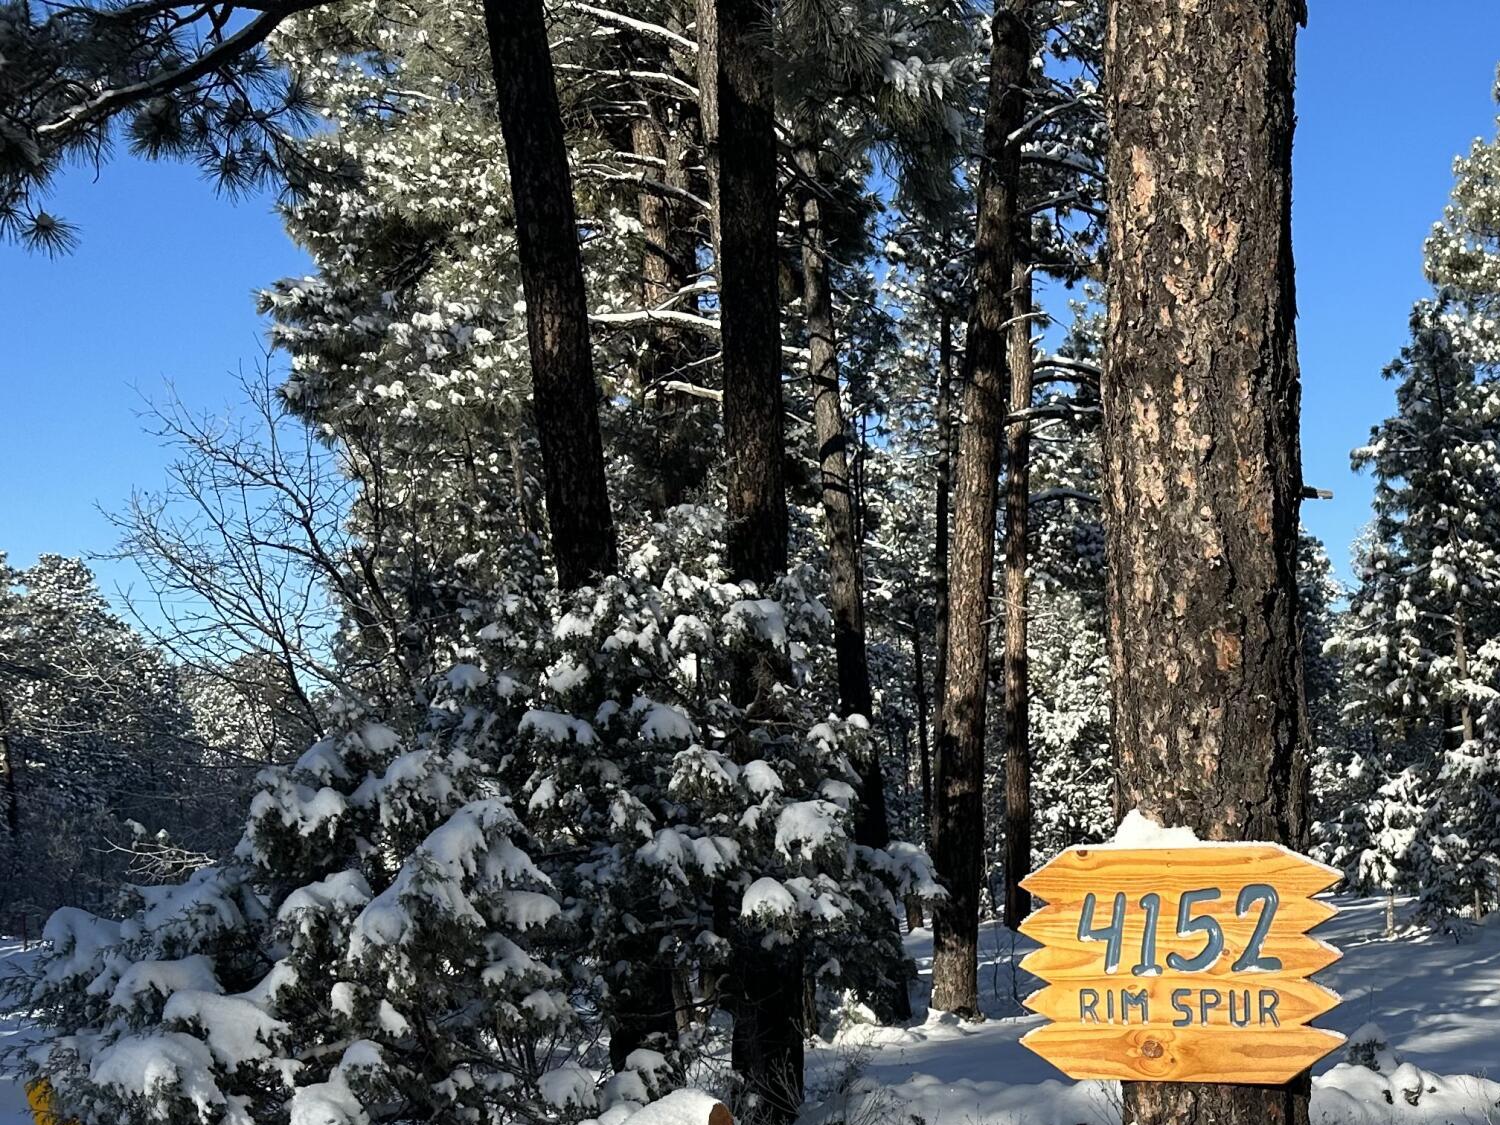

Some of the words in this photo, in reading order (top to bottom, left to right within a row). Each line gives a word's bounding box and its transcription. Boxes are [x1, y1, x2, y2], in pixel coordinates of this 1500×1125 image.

[1078, 883, 1282, 976] 4152
[1079, 988, 1149, 1026] RIM
[1171, 988, 1281, 1028] SPUR
